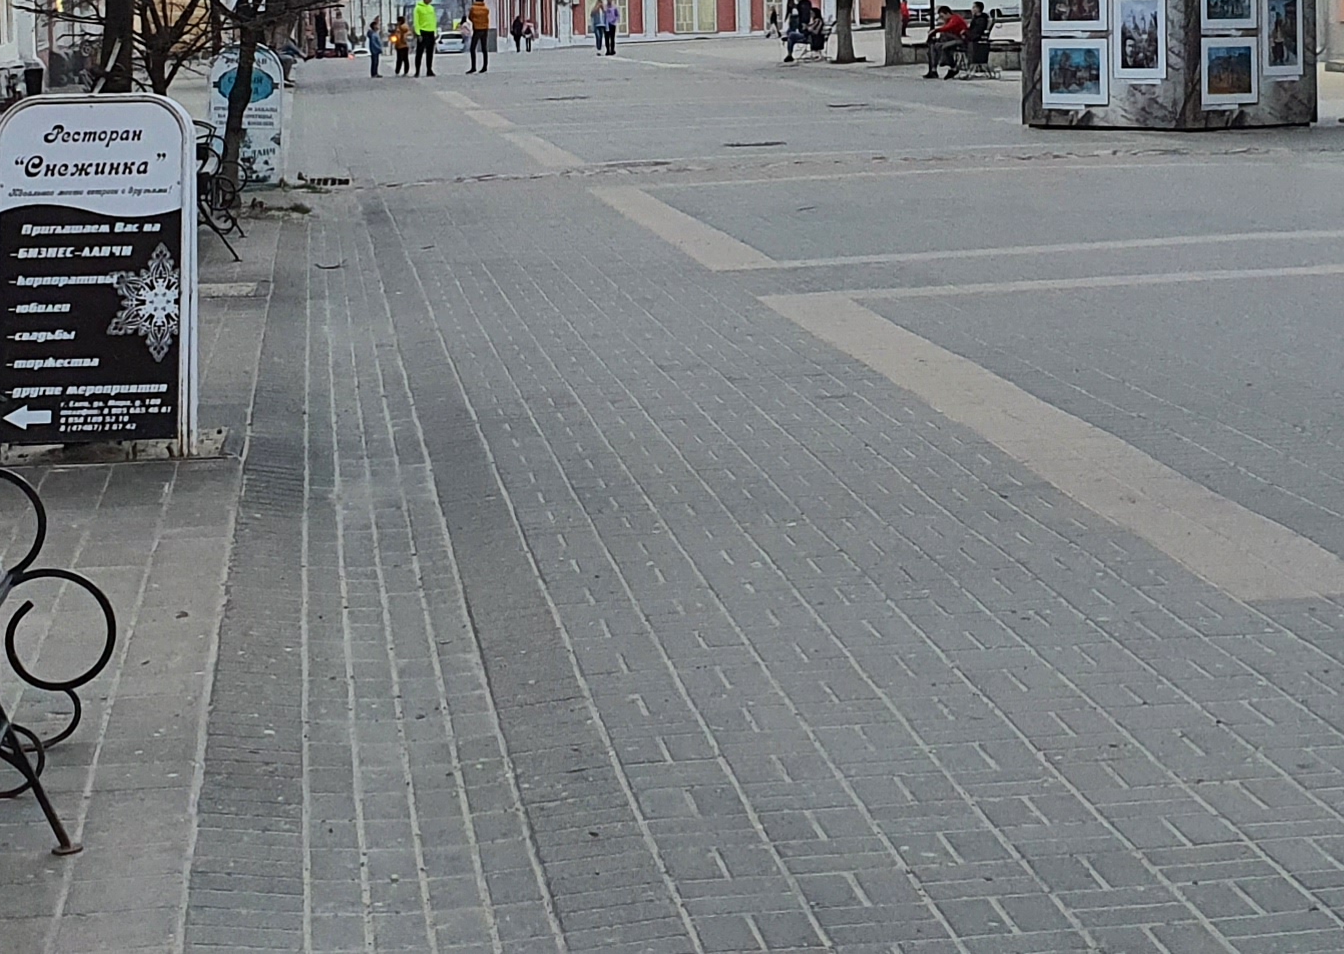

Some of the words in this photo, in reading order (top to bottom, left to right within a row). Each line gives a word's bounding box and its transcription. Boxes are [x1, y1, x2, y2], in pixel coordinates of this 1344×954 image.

[43, 124, 143, 147] Ресторан
[21, 223, 110, 237] Приглашаем
[114, 222, 139, 233] Вас
[65, 383, 168, 396] мероприятия
